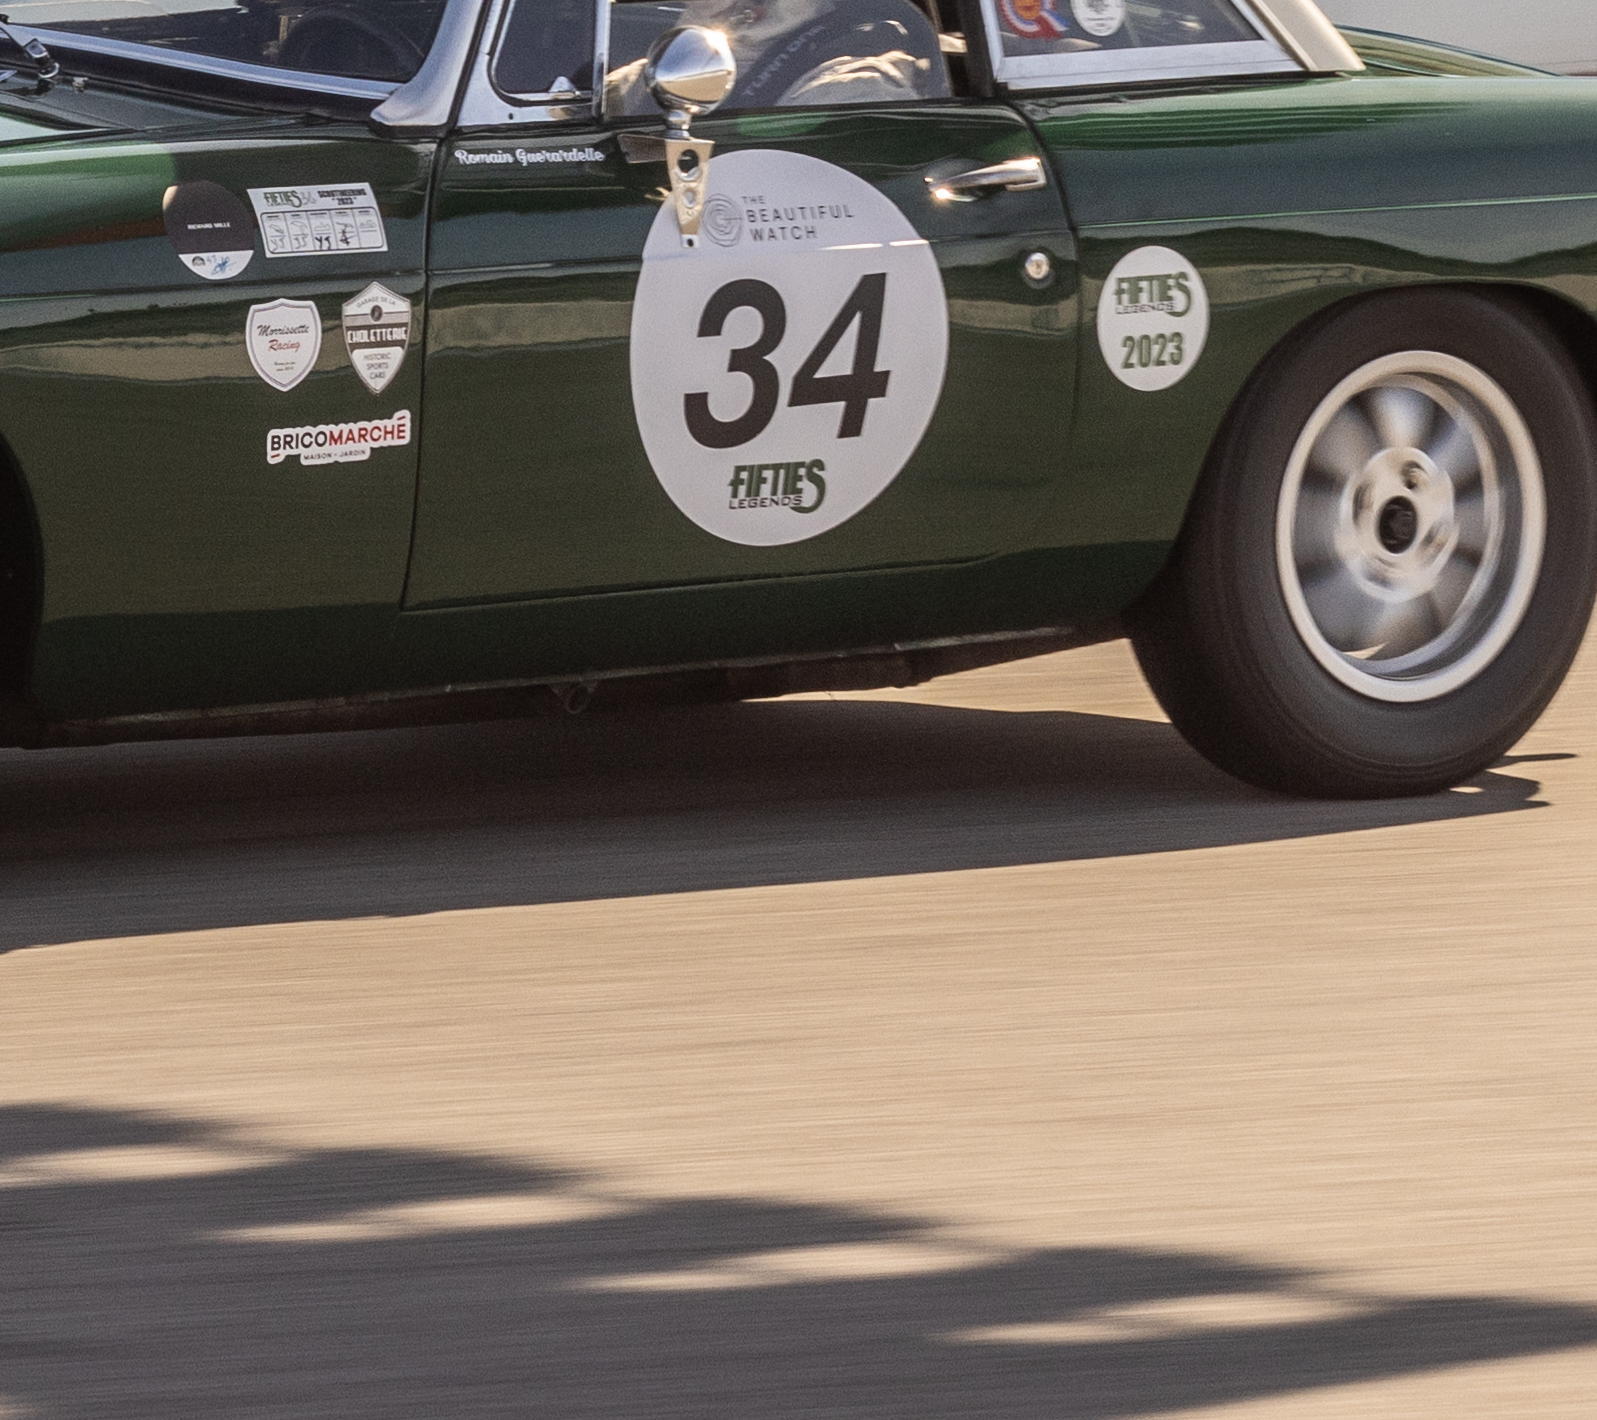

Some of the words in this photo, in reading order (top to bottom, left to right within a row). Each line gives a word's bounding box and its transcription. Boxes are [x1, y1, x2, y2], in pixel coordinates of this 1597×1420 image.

[454, 149, 514, 165] Romain
[742, 195, 766, 205] THE
[746, 204, 855, 223] BEAUTIFUL
[750, 225, 818, 242] WATCH
[1113, 271, 1192, 317] FIFTIES
[268, 339, 301, 353] Racing
[1122, 332, 1183, 369] 2023
[363, 352, 391, 361] HISTORIC
[683, 272, 891, 449] 34
[366, 362, 389, 371] SPORTS
[270, 415, 406, 452] BRICOMARCHÉ
[304, 452, 332, 461] MAISON
[339, 449, 366, 458] JARDIN
[728, 459, 826, 514] FIFTIES
[729, 496, 803, 510] LEGENDS
